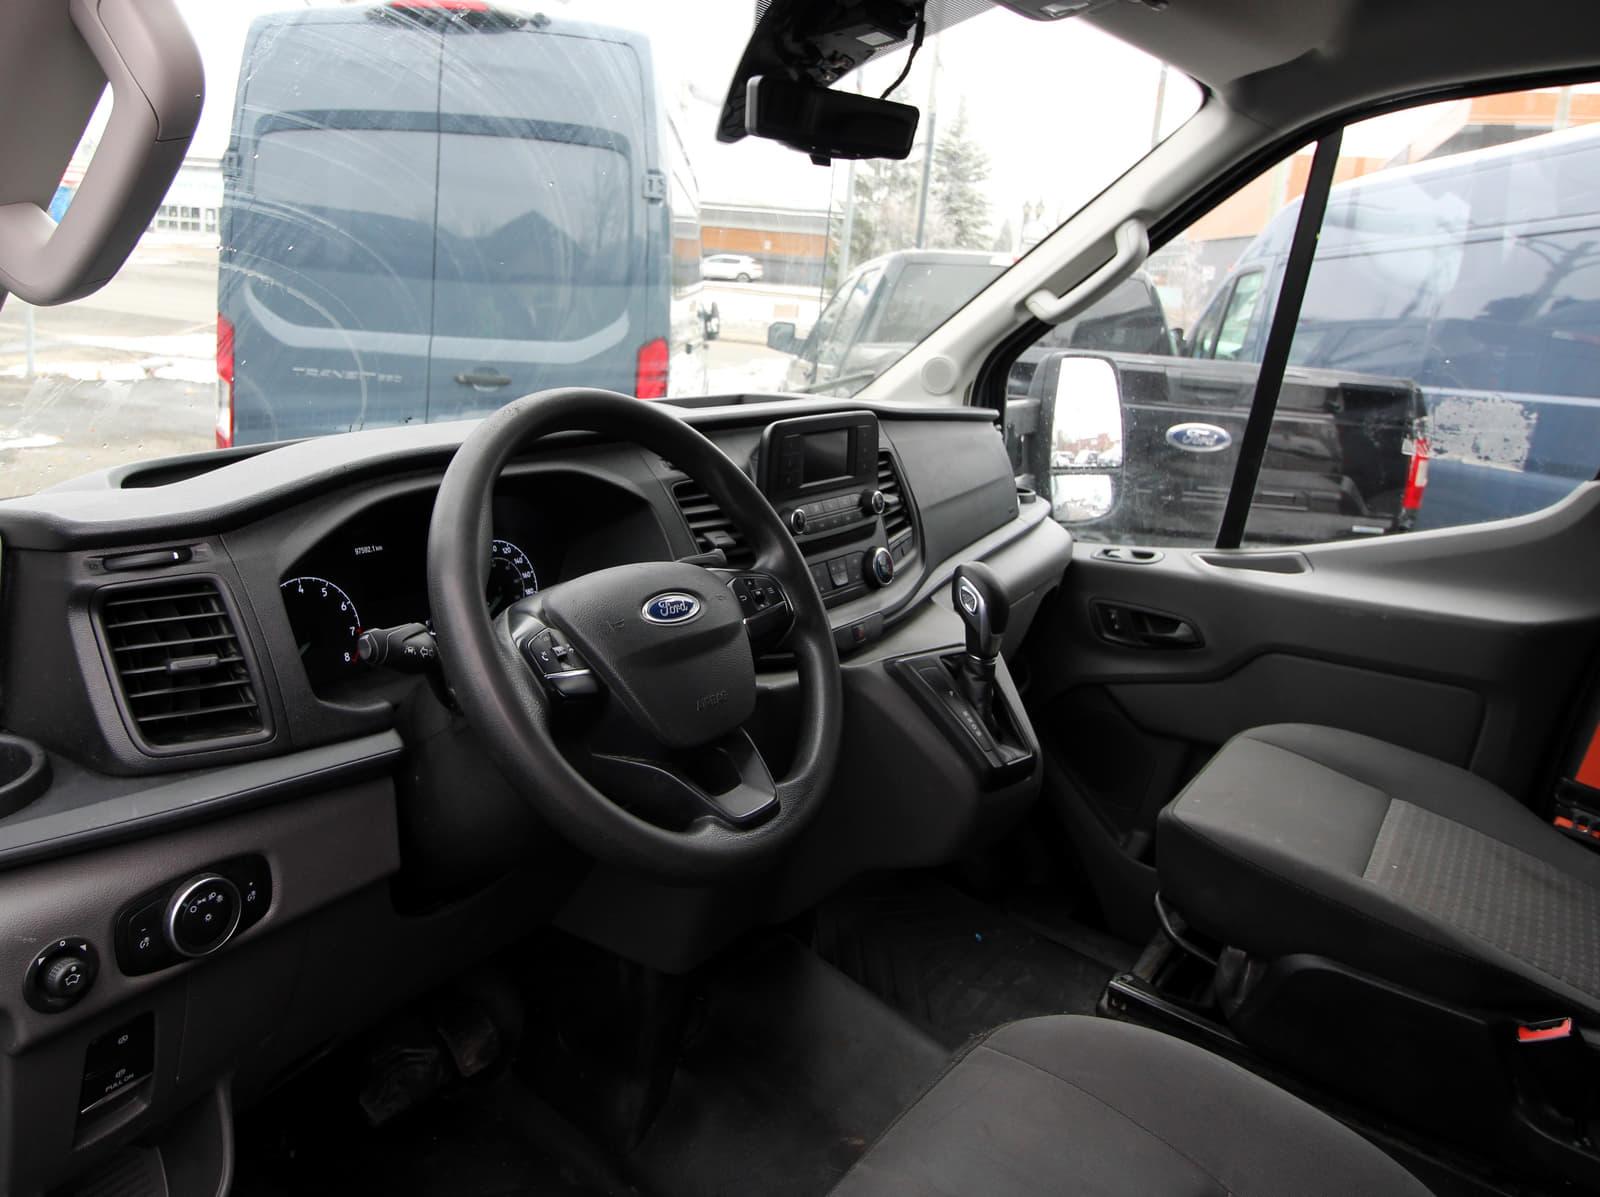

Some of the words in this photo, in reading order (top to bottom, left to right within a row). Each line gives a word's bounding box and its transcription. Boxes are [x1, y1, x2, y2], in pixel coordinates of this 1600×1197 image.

[298, 585, 304, 594] 4
[321, 588, 328, 597] 5
[341, 601, 347, 611] 6
[658, 600, 689, 616] Ford
[349, 626, 355, 636] 7
[344, 652, 350, 662] 8
